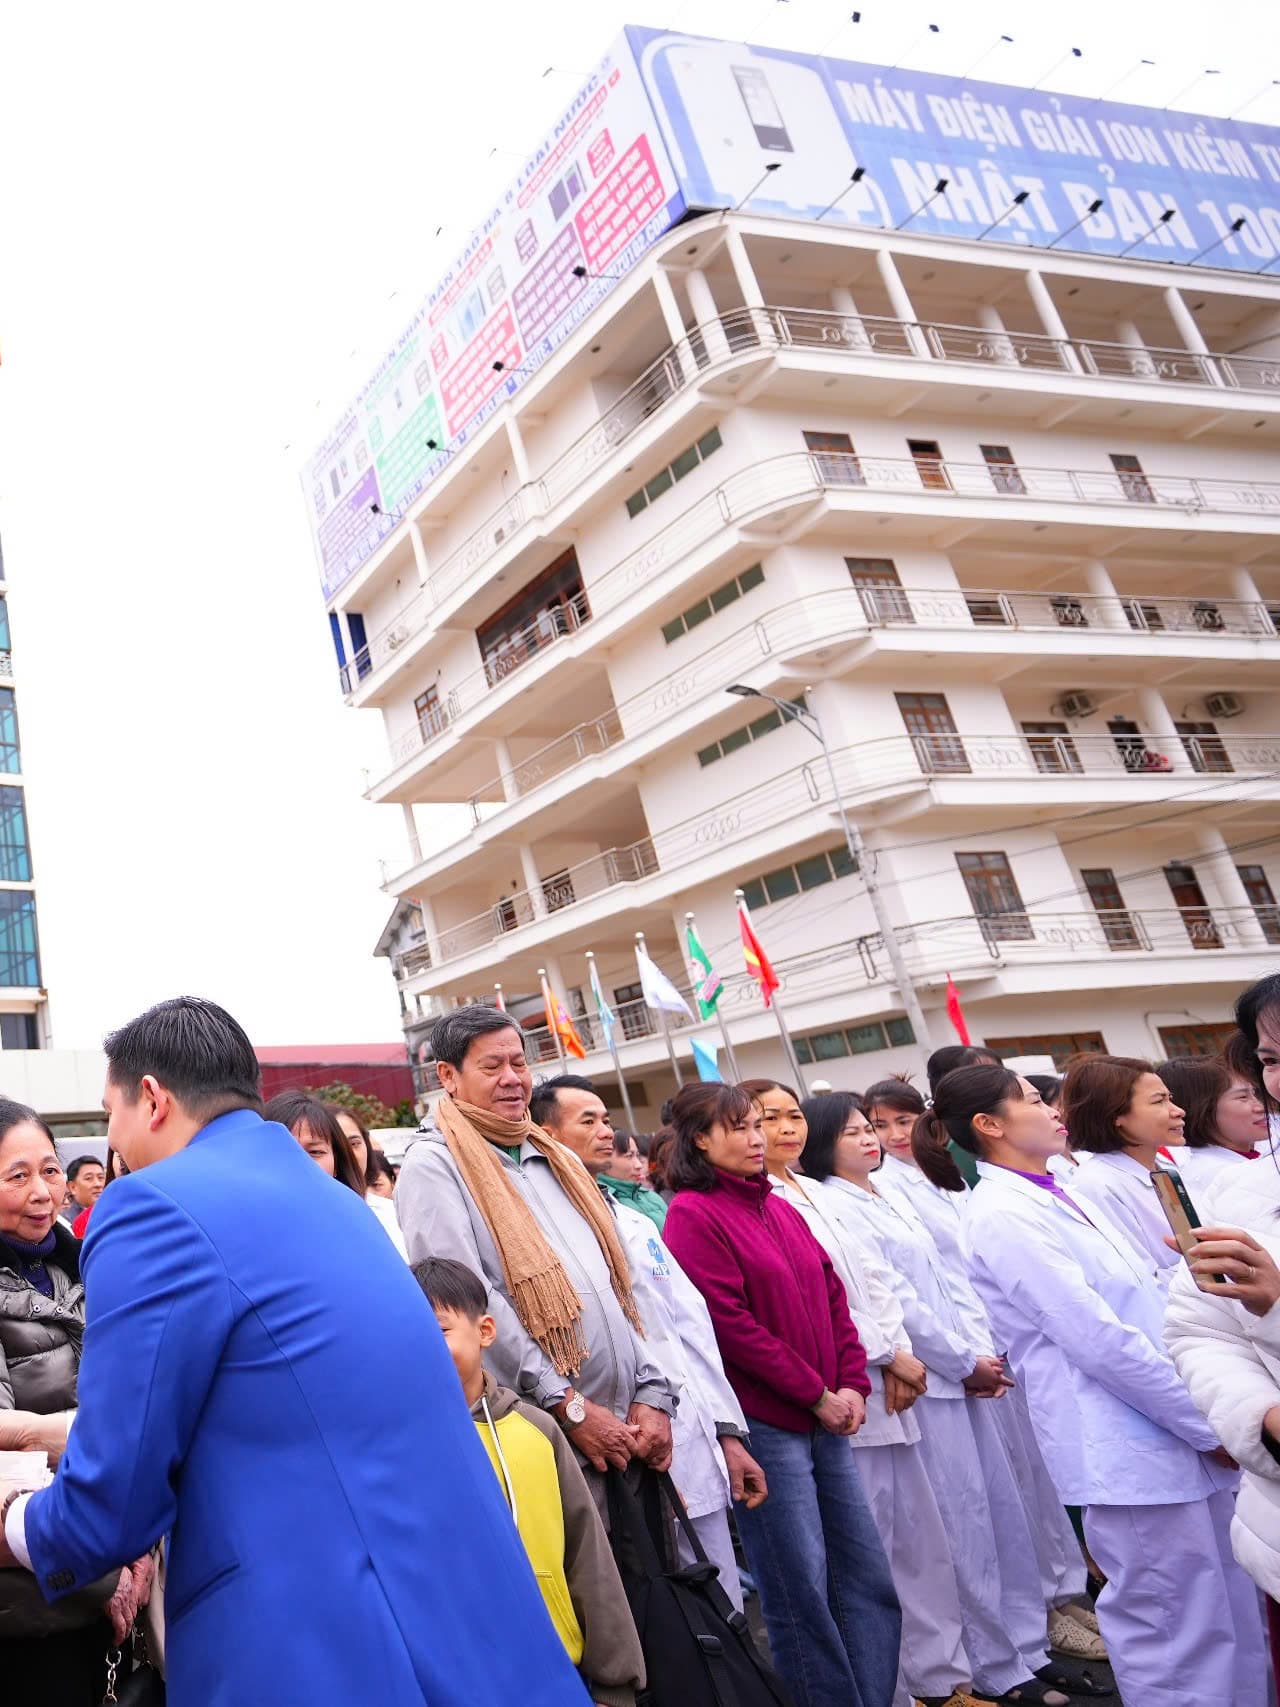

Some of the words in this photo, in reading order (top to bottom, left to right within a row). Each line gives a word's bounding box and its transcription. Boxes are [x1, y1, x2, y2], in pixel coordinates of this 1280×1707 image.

[834, 78, 925, 133] MÁY
[925, 91, 1023, 152] ĐIỆN
[1020, 97, 1102, 158] GIẢI
[1096, 119, 1170, 168] ION
[889, 157, 1060, 242] NHẬT
[1060, 163, 1200, 250] BẢN
